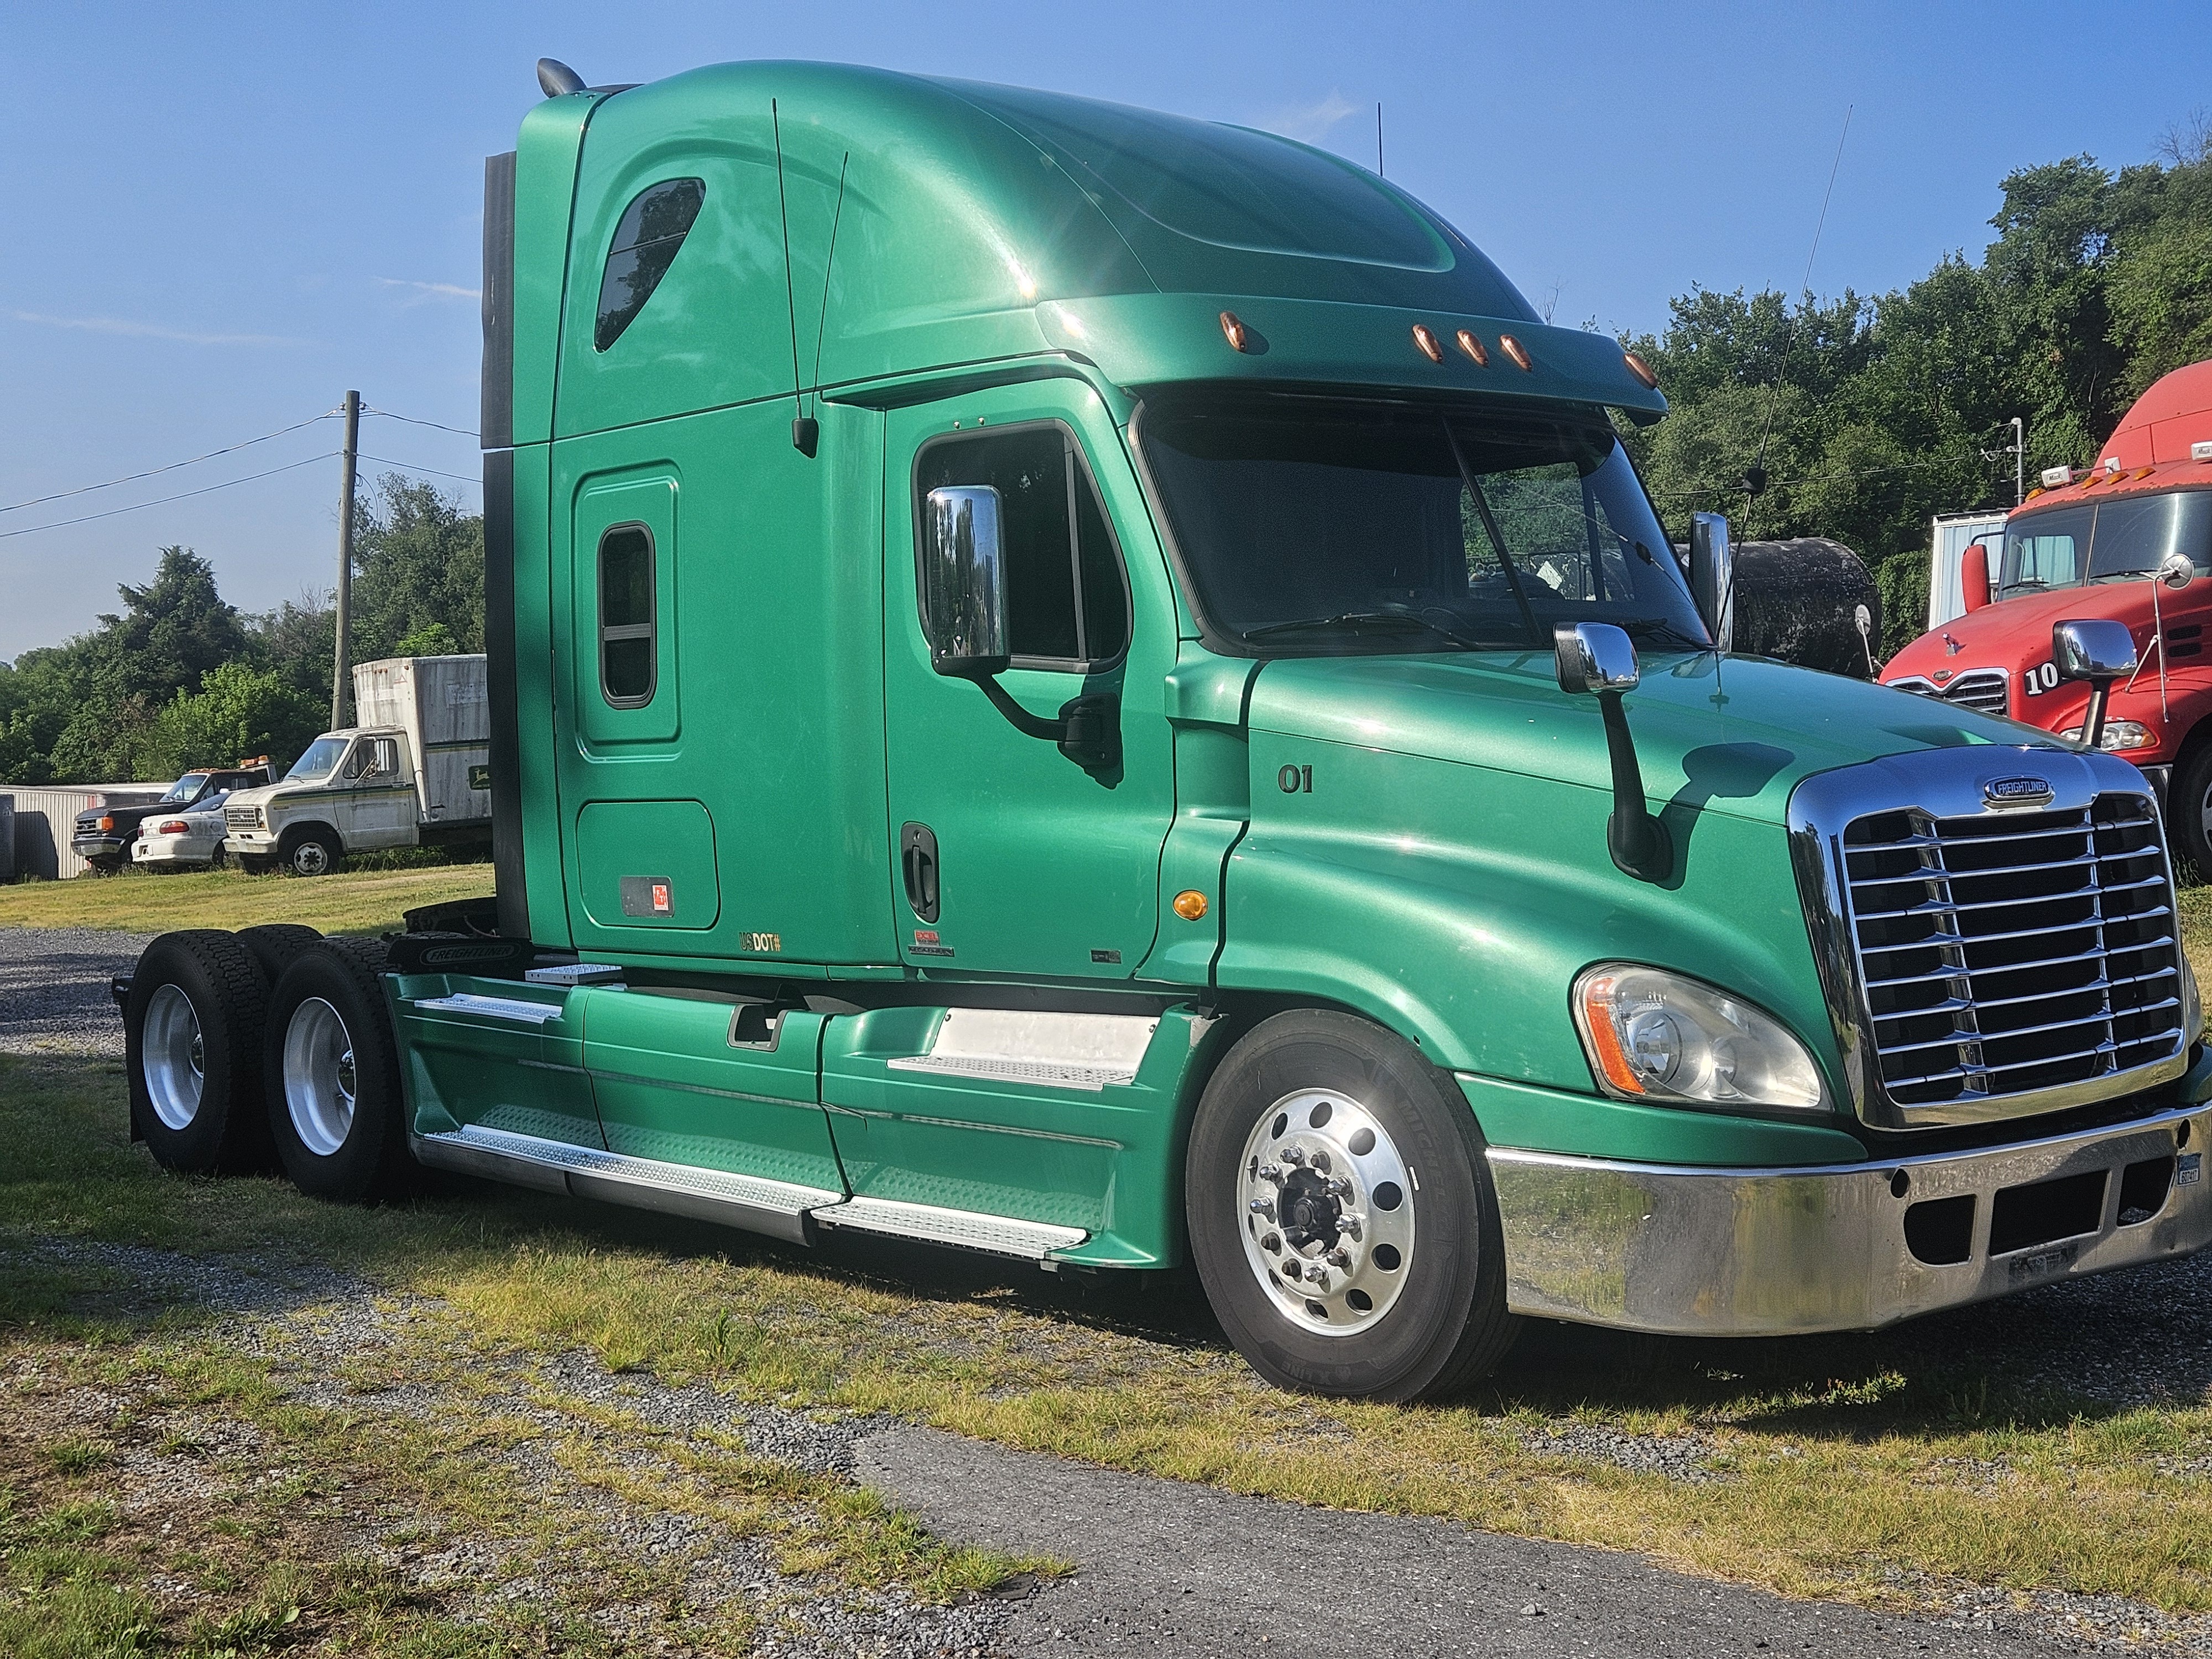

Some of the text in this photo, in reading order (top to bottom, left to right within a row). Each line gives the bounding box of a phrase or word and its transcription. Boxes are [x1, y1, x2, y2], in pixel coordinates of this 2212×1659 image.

[2027, 662, 2070, 695] 10
[1278, 764, 1312, 794] 01
[1997, 781, 2047, 794] FREIGHTLINER
[430, 947, 511, 960] FREIGHTLINER
